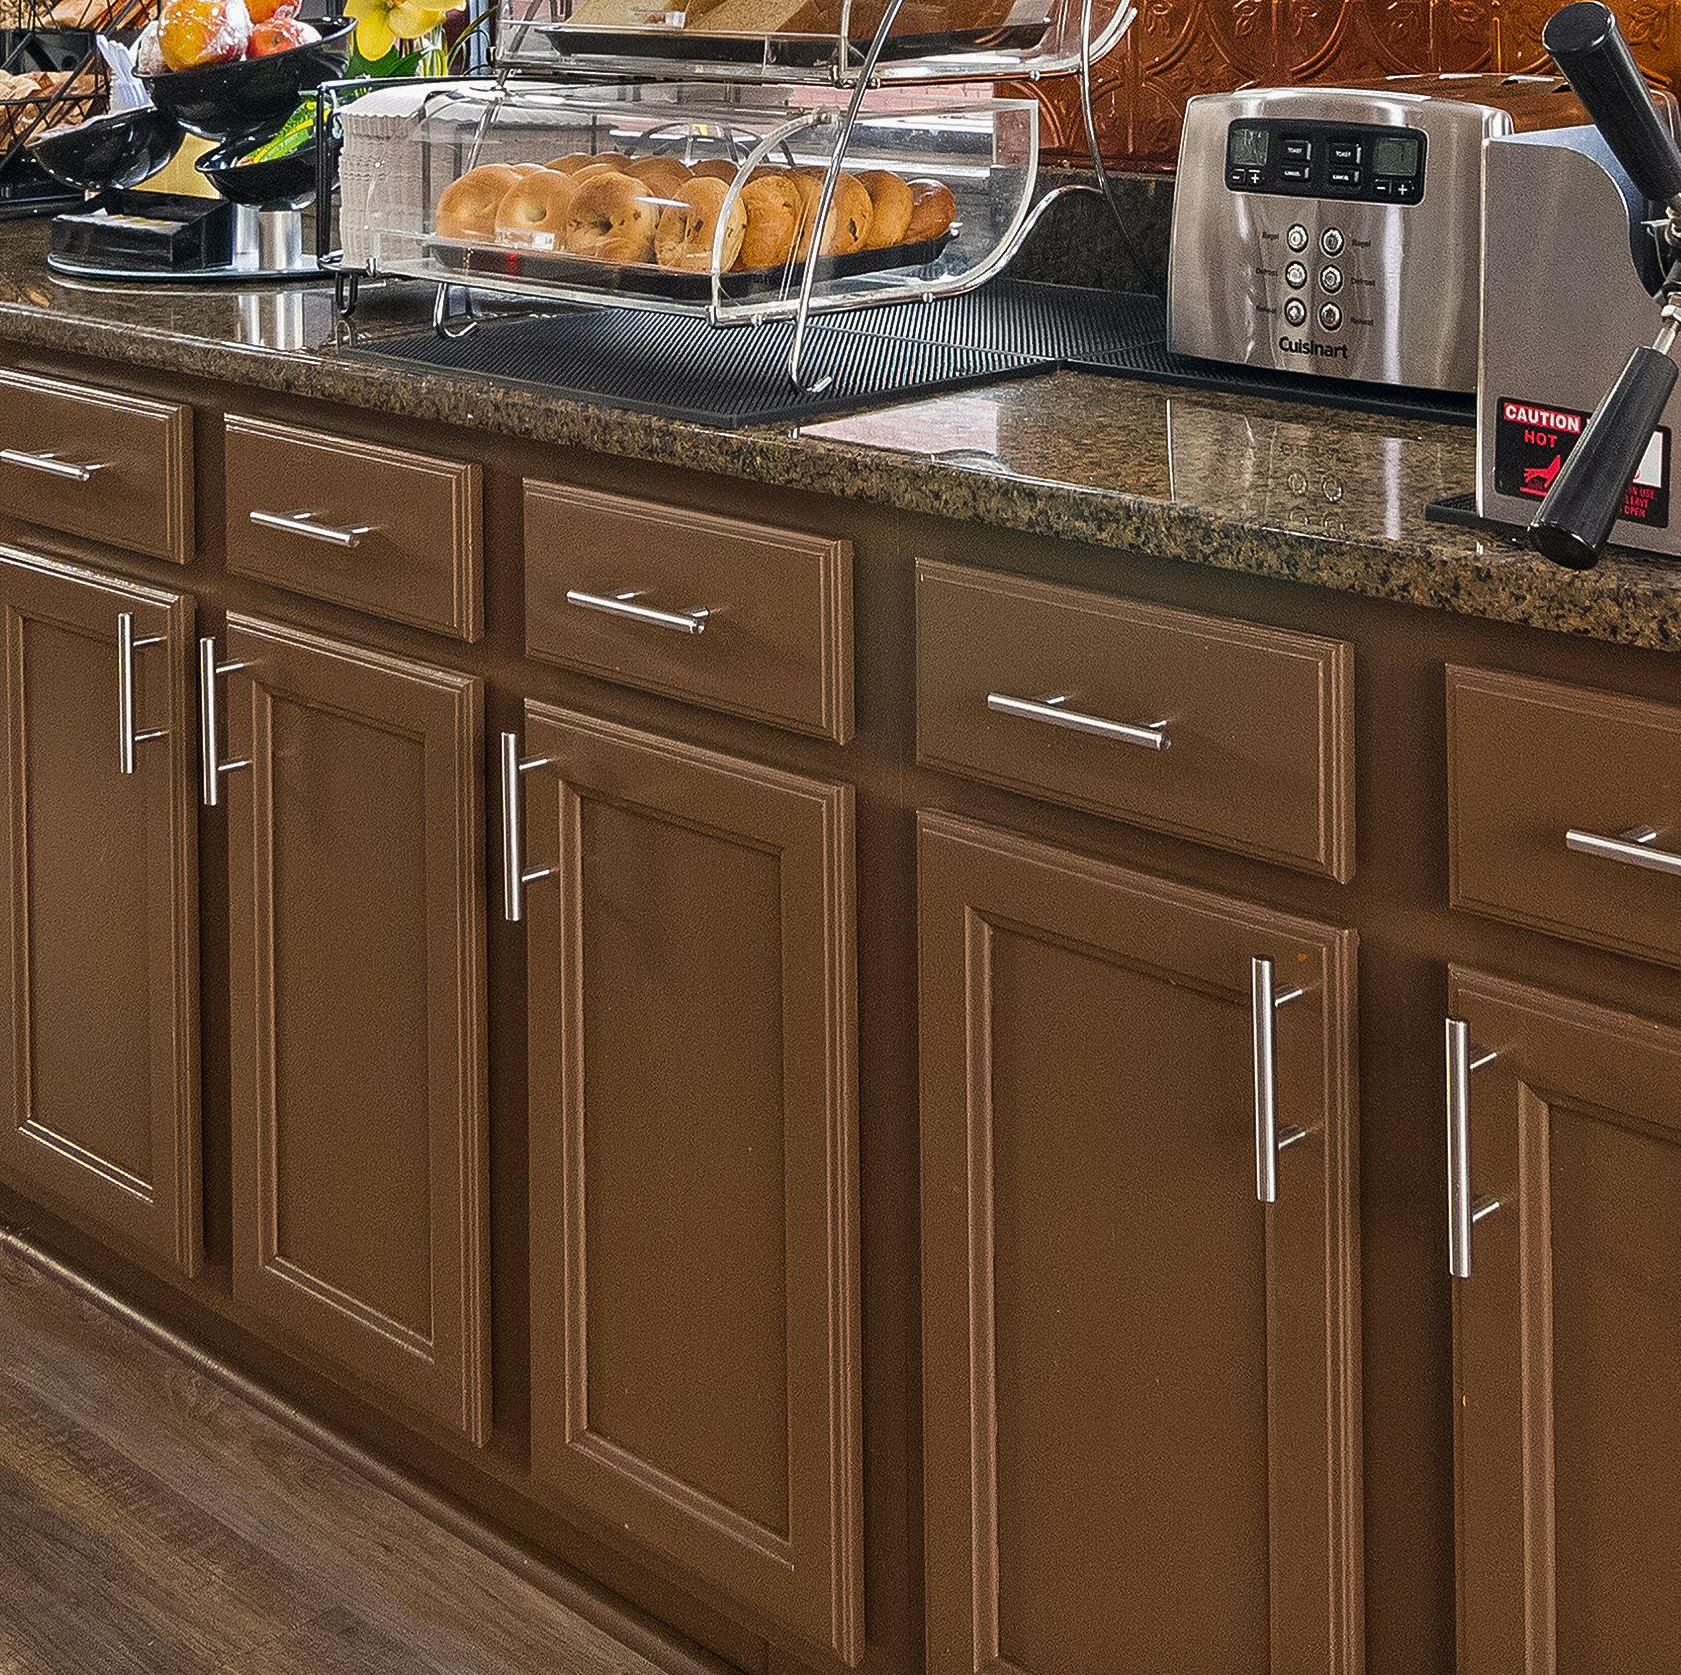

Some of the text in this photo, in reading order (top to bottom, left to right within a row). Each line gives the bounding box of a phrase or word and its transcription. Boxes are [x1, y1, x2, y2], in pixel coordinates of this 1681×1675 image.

[1279, 336, 1348, 359] Cuisinart
[1505, 404, 1581, 432] CAUTION
[1524, 429, 1558, 448] HOT
[1639, 488, 1656, 500] USE
[1624, 505, 1646, 517] OPEN
